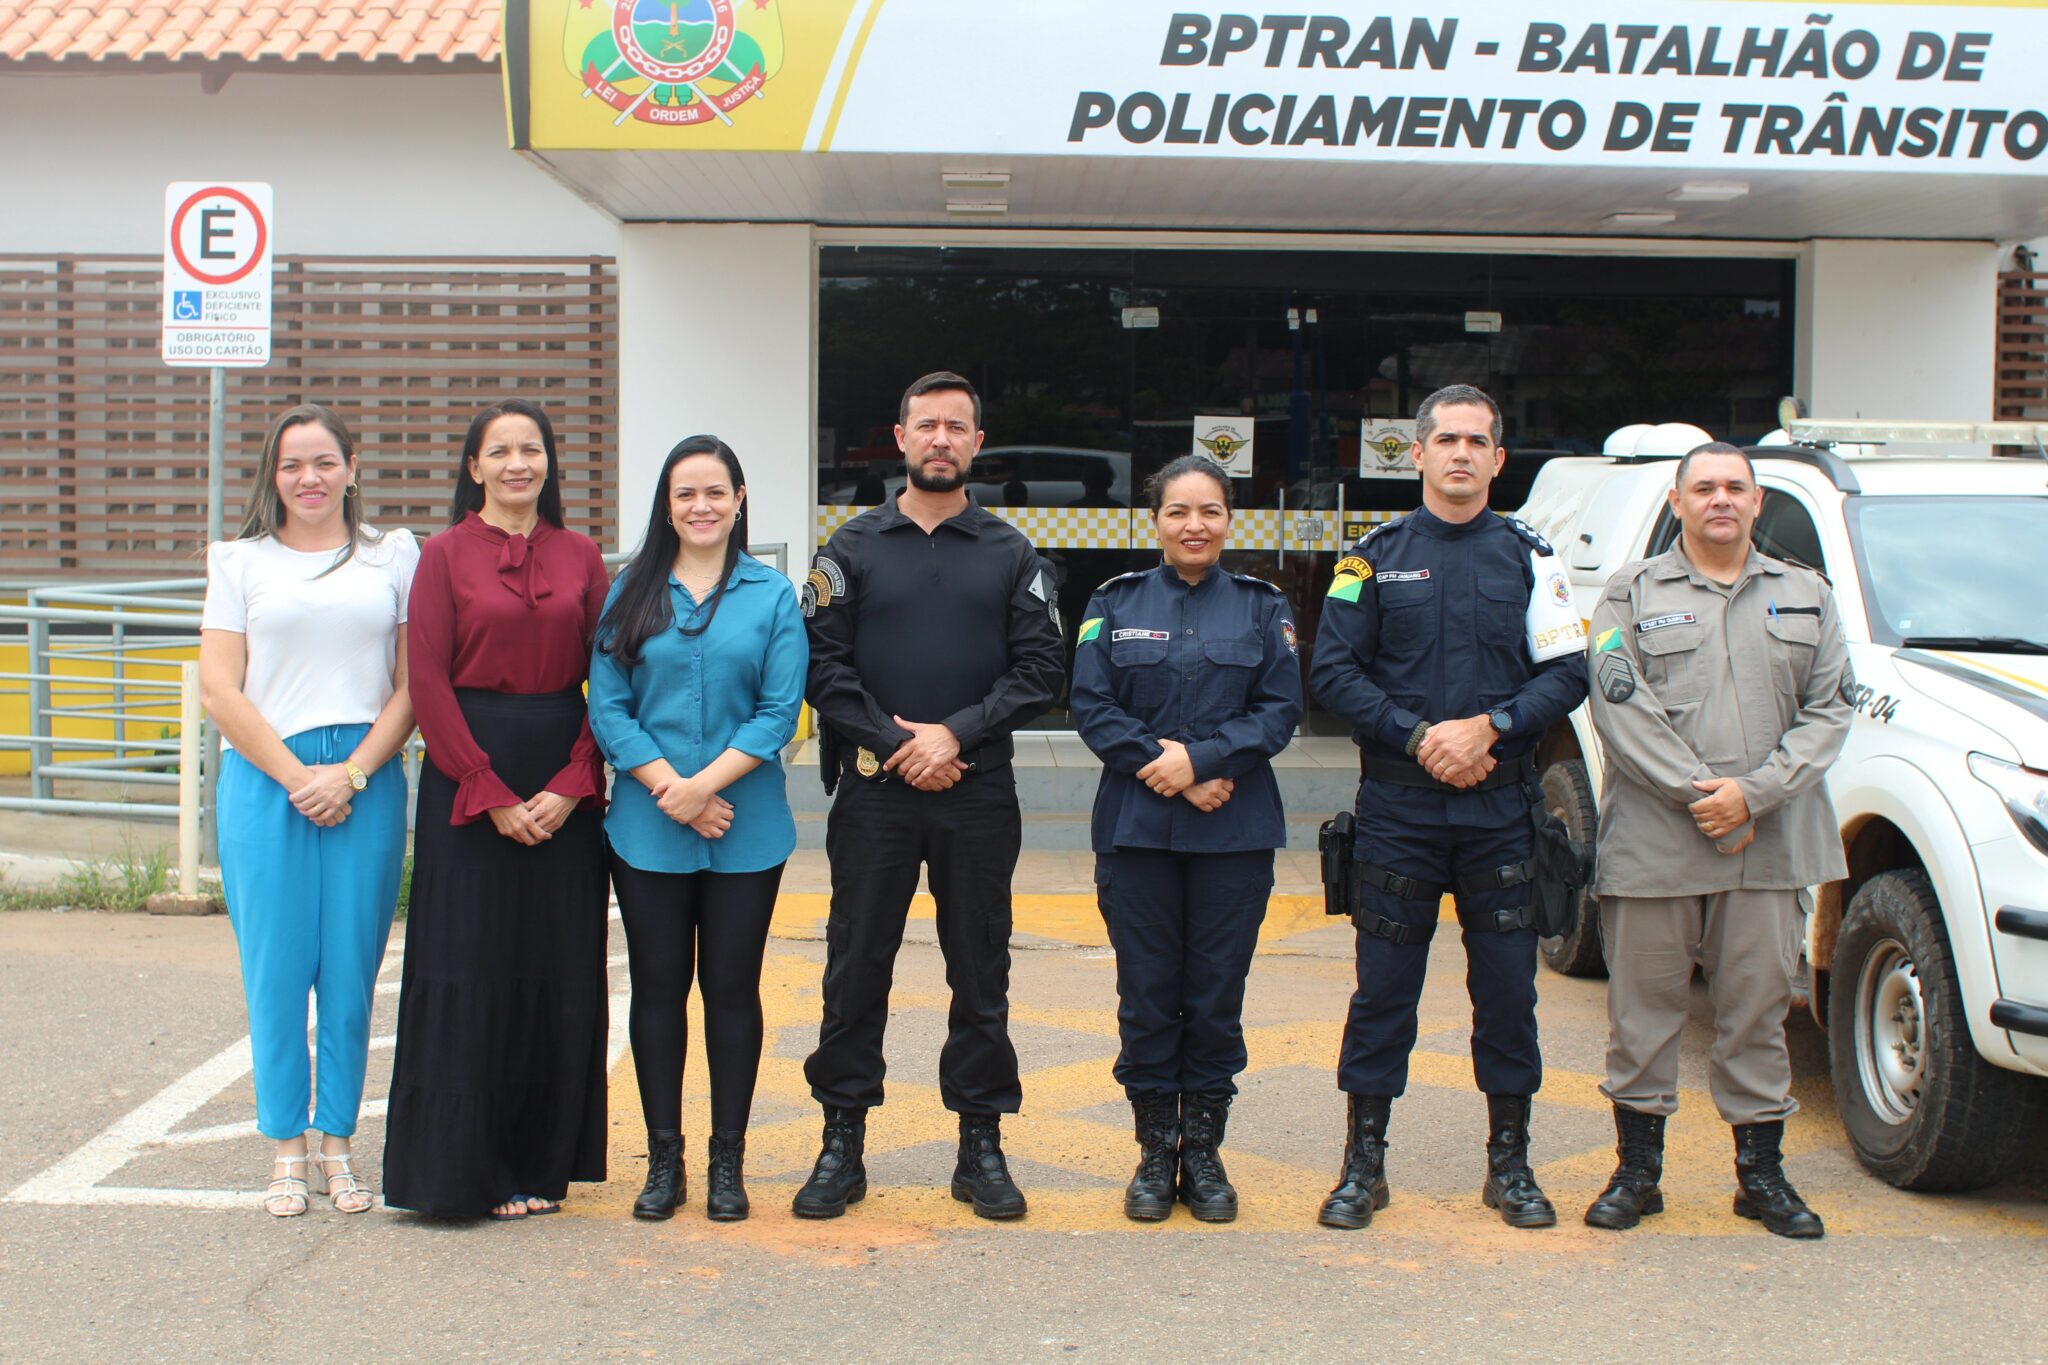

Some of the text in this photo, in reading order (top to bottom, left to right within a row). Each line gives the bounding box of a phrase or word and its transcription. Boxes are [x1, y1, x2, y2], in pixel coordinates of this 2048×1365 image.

[1161, 14, 1993, 82] BPTRAN - BATALHÃO DE
[595, 80, 618, 103] LEI
[722, 75, 760, 108] JUSTIÇA
[649, 108, 699, 121] ORDEM
[1067, 91, 2048, 160] POLICIAMENTO DE TRÂNSITO
[200, 209, 236, 259] E
[205, 291, 261, 299] EXCLUSIVO
[205, 302, 262, 310] DEFICIENTE
[177, 331, 255, 343] OBRIGATÓRIO
[169, 344, 263, 356] USO DO CARTÃO
